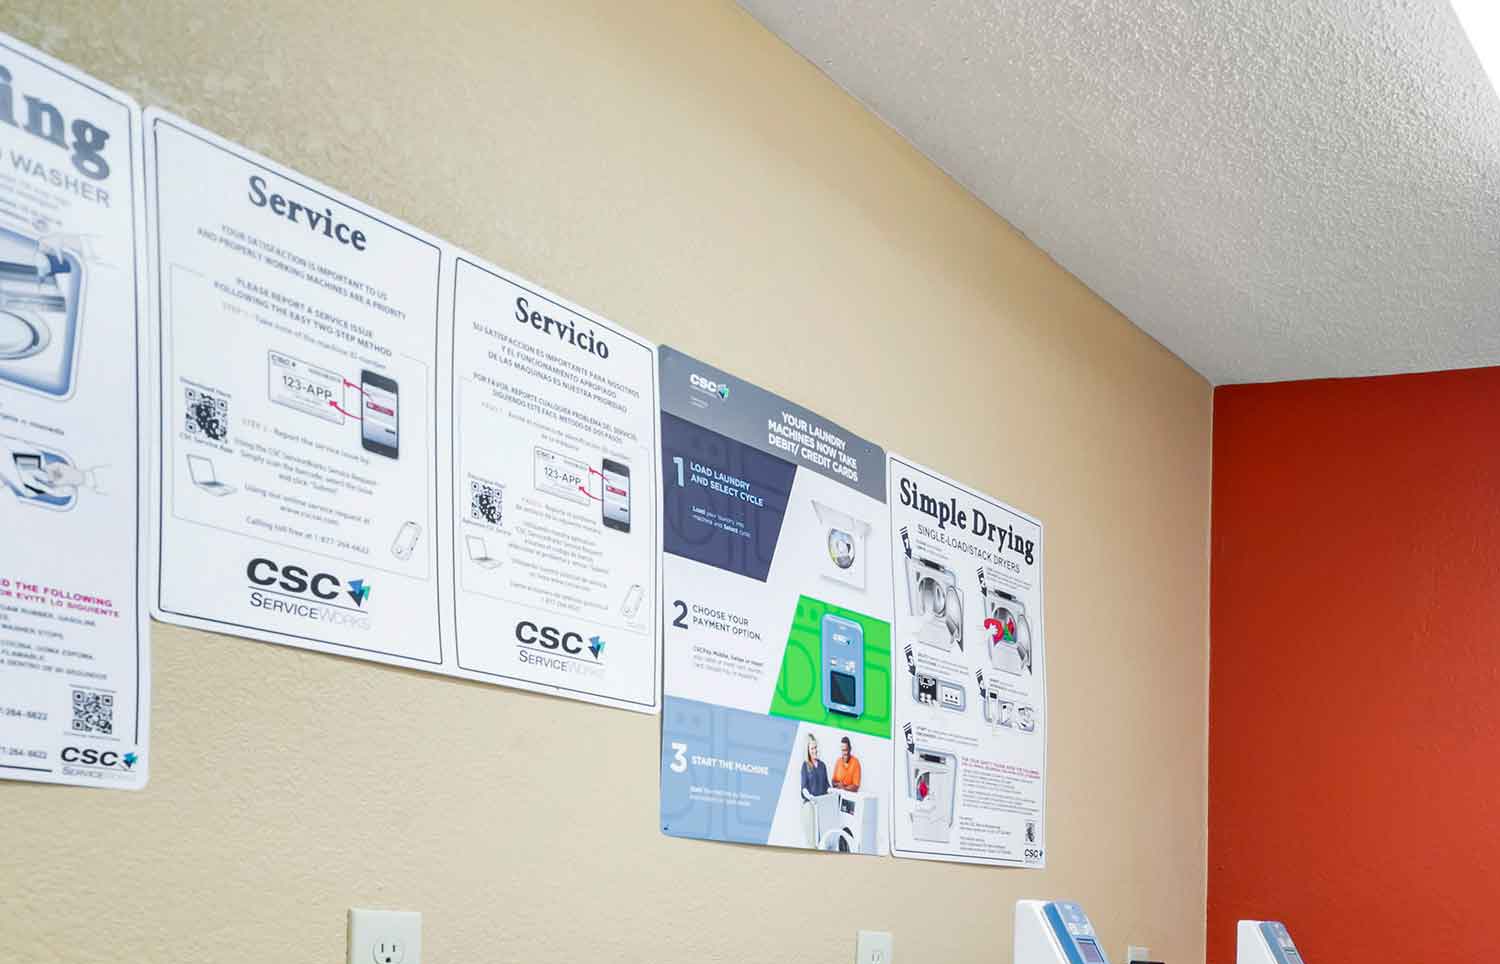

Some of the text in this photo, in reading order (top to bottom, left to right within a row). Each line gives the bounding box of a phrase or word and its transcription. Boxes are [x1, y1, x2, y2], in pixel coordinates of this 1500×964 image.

[10, 149, 110, 209] WASHER
[248, 175, 368, 251] Service
[306, 273, 349, 298] MACHINES
[271, 300, 287, 317] THE
[289, 310, 311, 326] EASY
[356, 337, 392, 357] METHOD
[314, 308, 349, 330] SERVICE
[514, 297, 610, 360] Servicio
[282, 374, 333, 400] 123-APP
[689, 373, 718, 393] CSC
[768, 418, 858, 471] MACHINES NOW TAKE
[782, 411, 847, 451] YOUR LAUNDRY
[543, 466, 582, 486] 123-APP
[673, 456, 685, 487] 1
[690, 461, 750, 491] LOAD LAUNDRY
[801, 447, 831, 470] CREDIT
[832, 461, 859, 482] CARDS
[690, 473, 764, 507] AND SELECT CYCLE
[900, 477, 1035, 566] Simple Drying
[246, 558, 341, 600] CSC
[993, 554, 1021, 575] DRYERS
[16, 581, 38, 593] THE
[43, 587, 113, 607] FOLLOWING
[16, 592, 120, 618] EVITE LO SIGUIENTE
[672, 600, 689, 630] 2
[692, 604, 749, 627] CHOOSE YOUR
[692, 616, 731, 633] PAYMENT
[515, 621, 584, 655] CSC
[61, 747, 118, 767] CSC
[670, 741, 688, 773] 3
[691, 755, 718, 768] START
[1024, 848, 1039, 858] CSC
